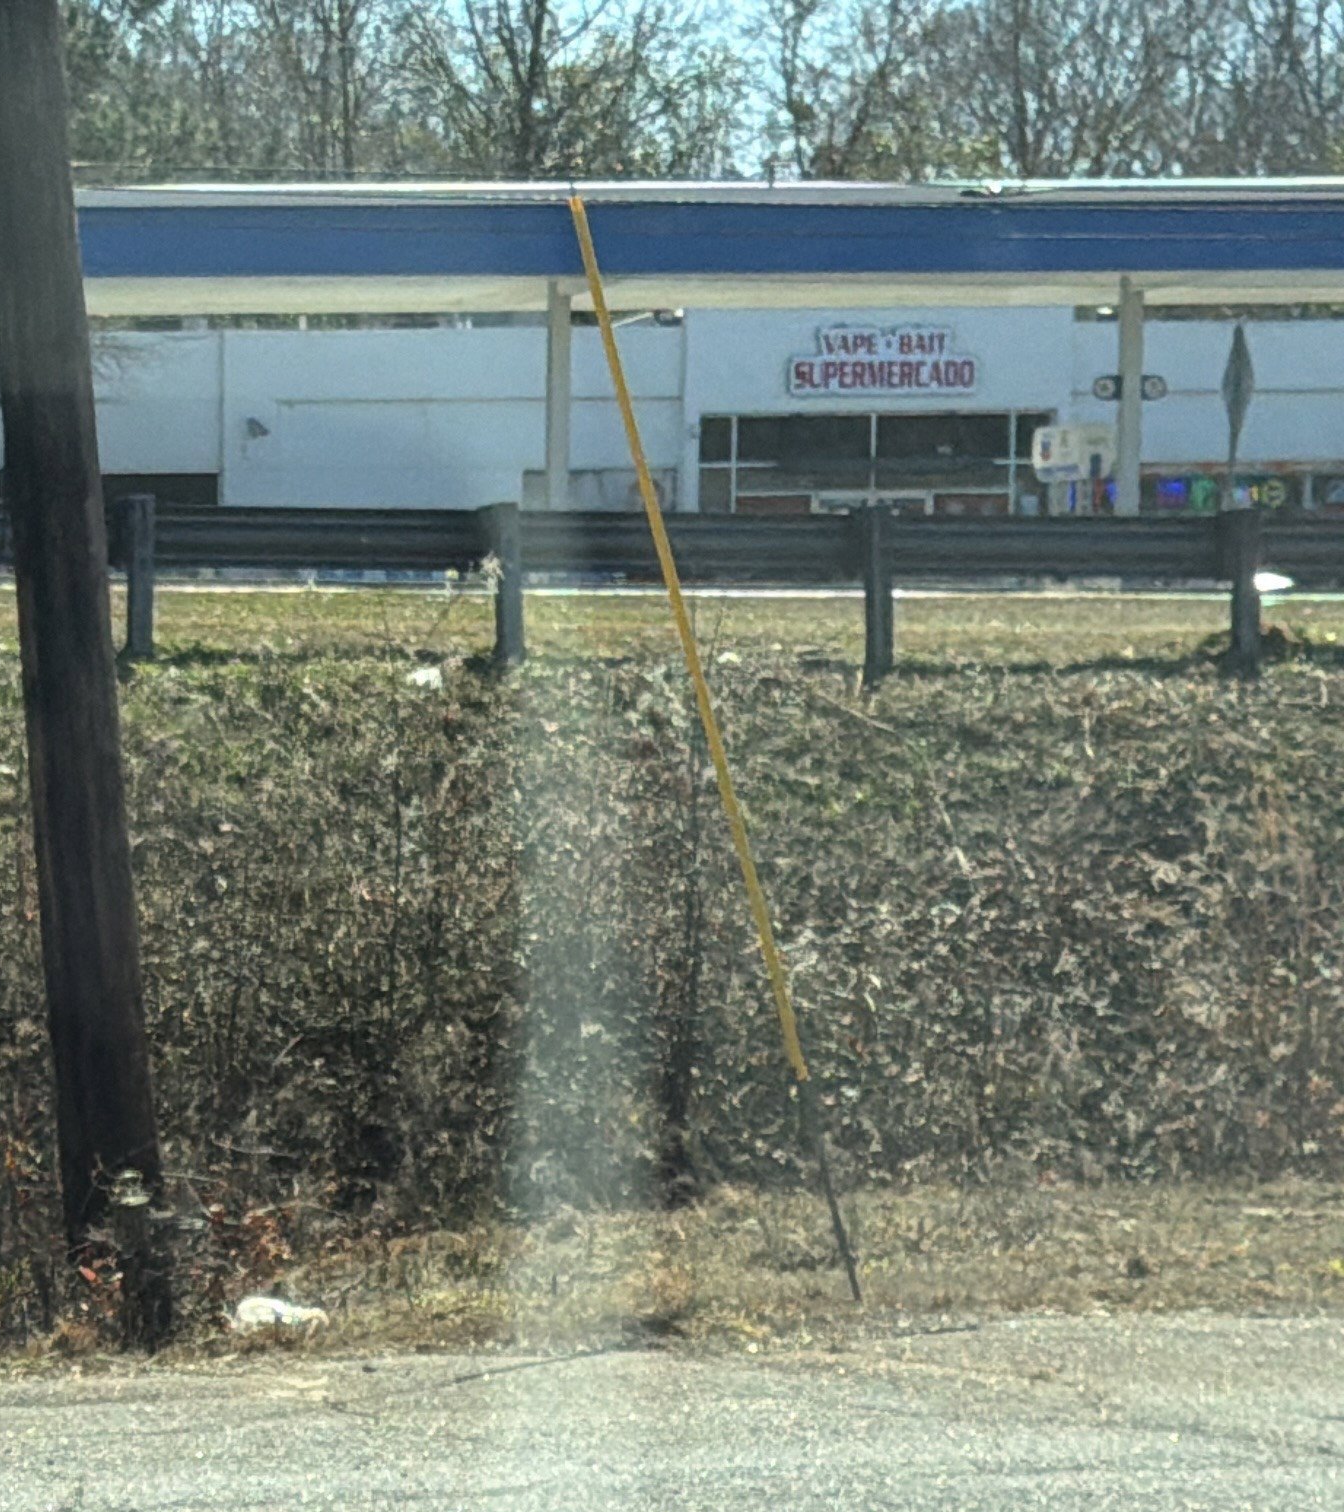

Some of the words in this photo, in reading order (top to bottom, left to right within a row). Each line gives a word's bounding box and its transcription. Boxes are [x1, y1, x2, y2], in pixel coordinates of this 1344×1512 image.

[822, 333, 877, 355] VAPE
[898, 332, 946, 355] BAIT
[793, 360, 975, 389] SUPERMERCADO
